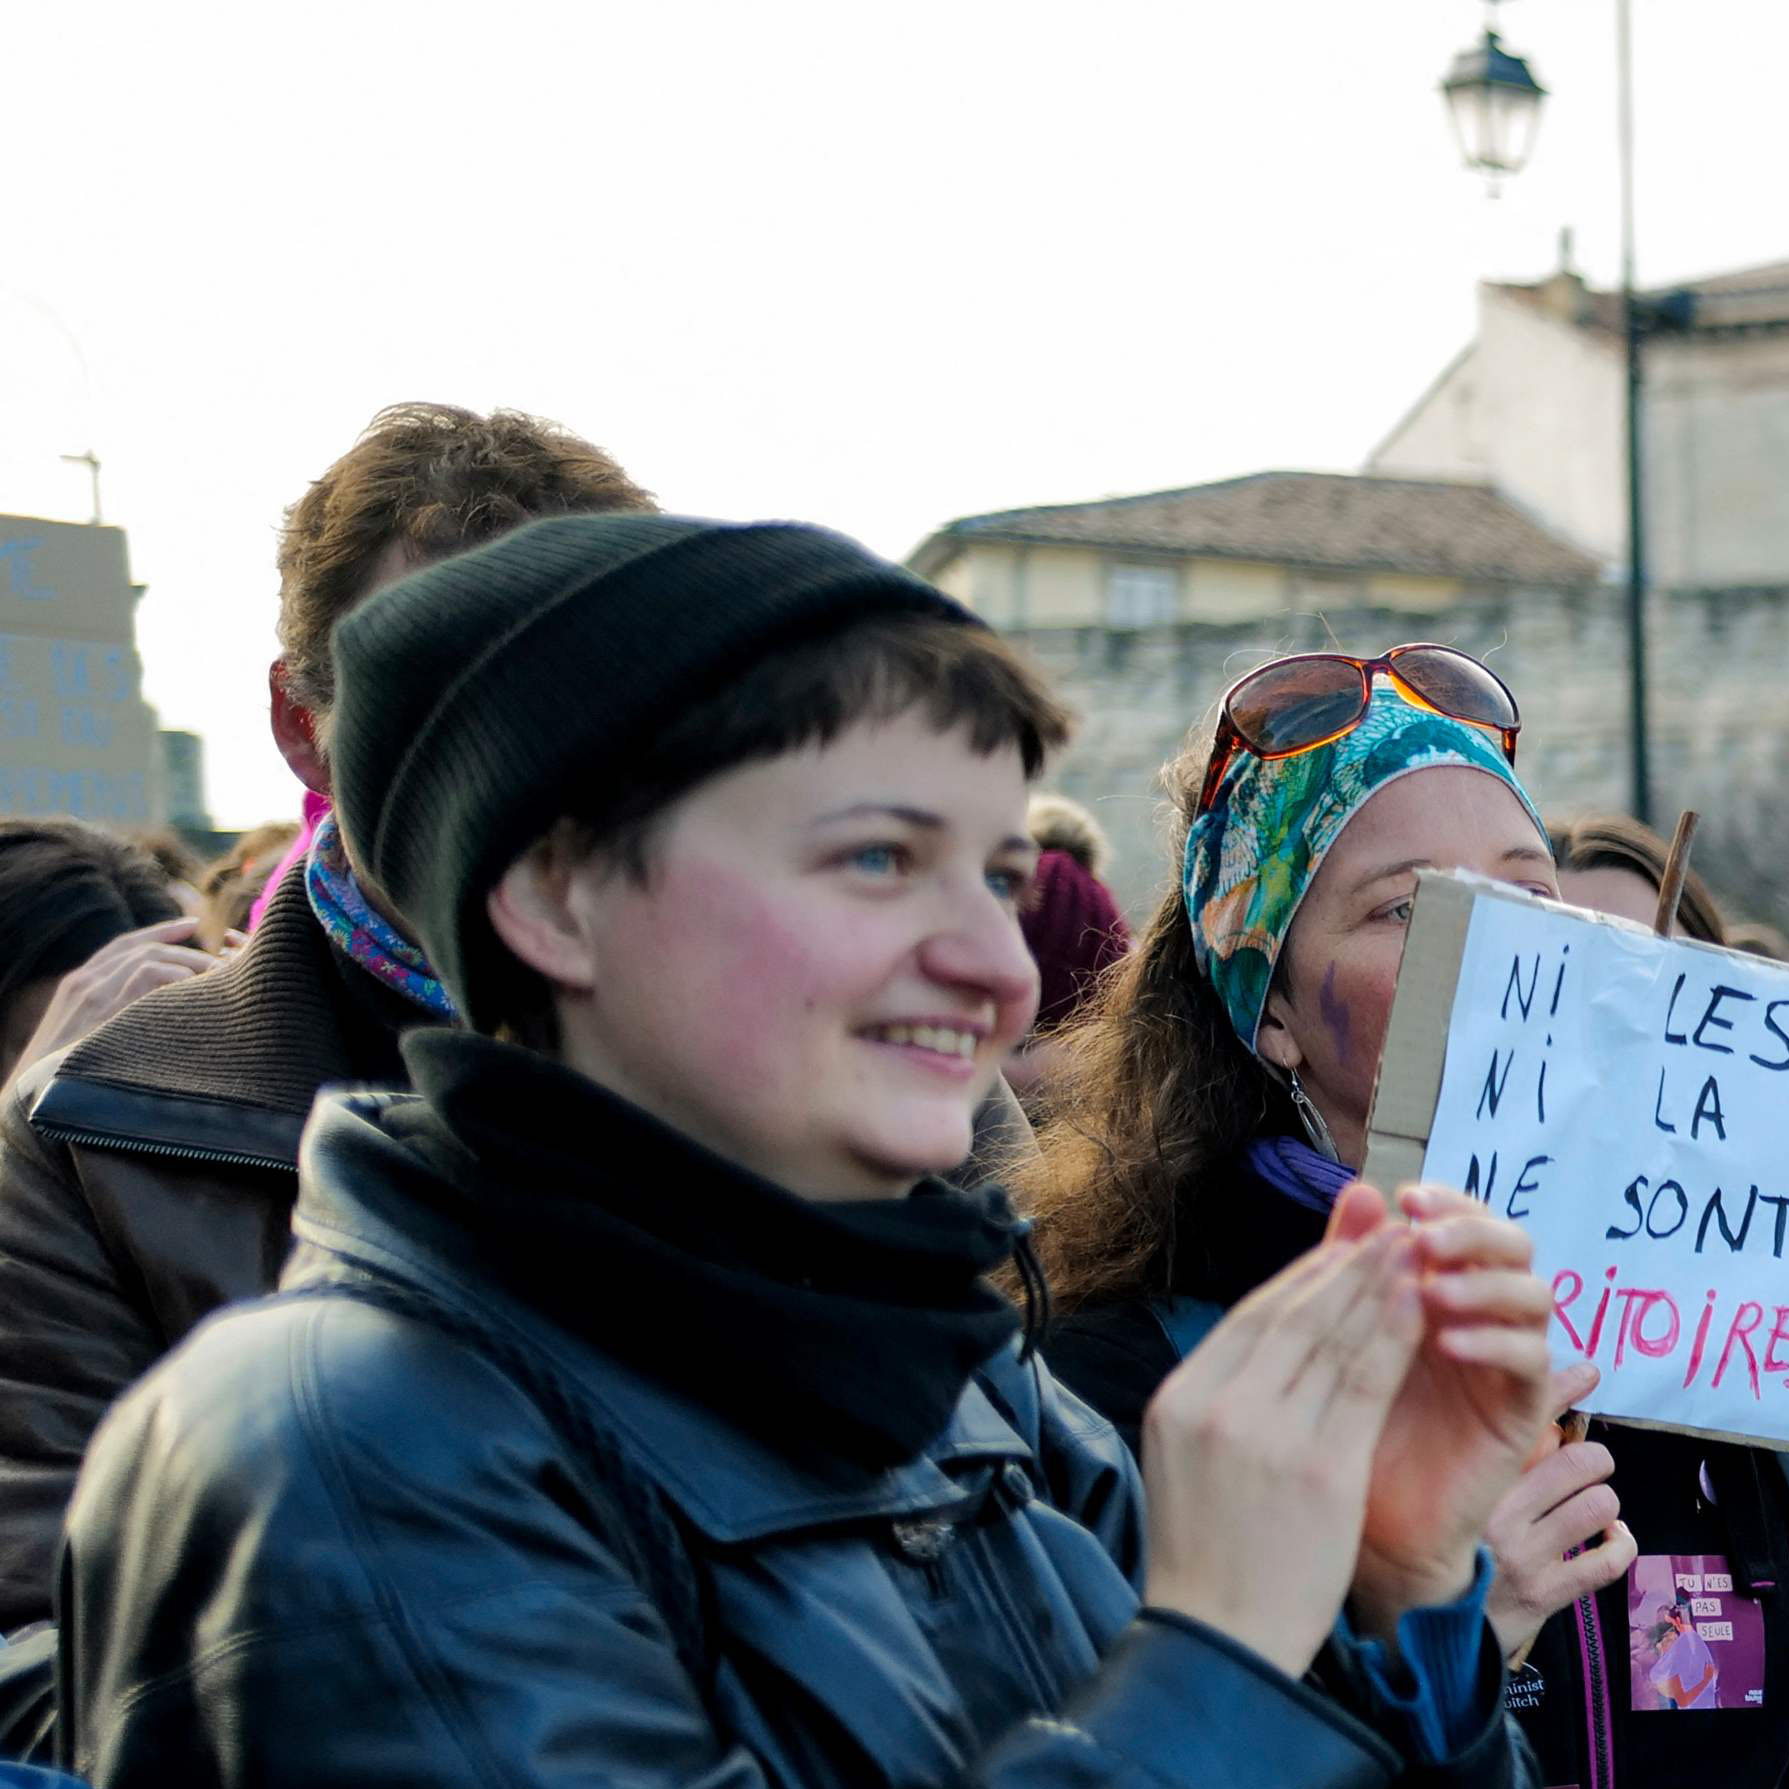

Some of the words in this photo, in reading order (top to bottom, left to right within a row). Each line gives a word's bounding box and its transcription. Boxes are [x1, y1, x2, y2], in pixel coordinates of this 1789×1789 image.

[1654, 1066, 1727, 1141] LA
[1463, 1151, 1556, 1220] NE
[1695, 1602, 1717, 1612] PAS
